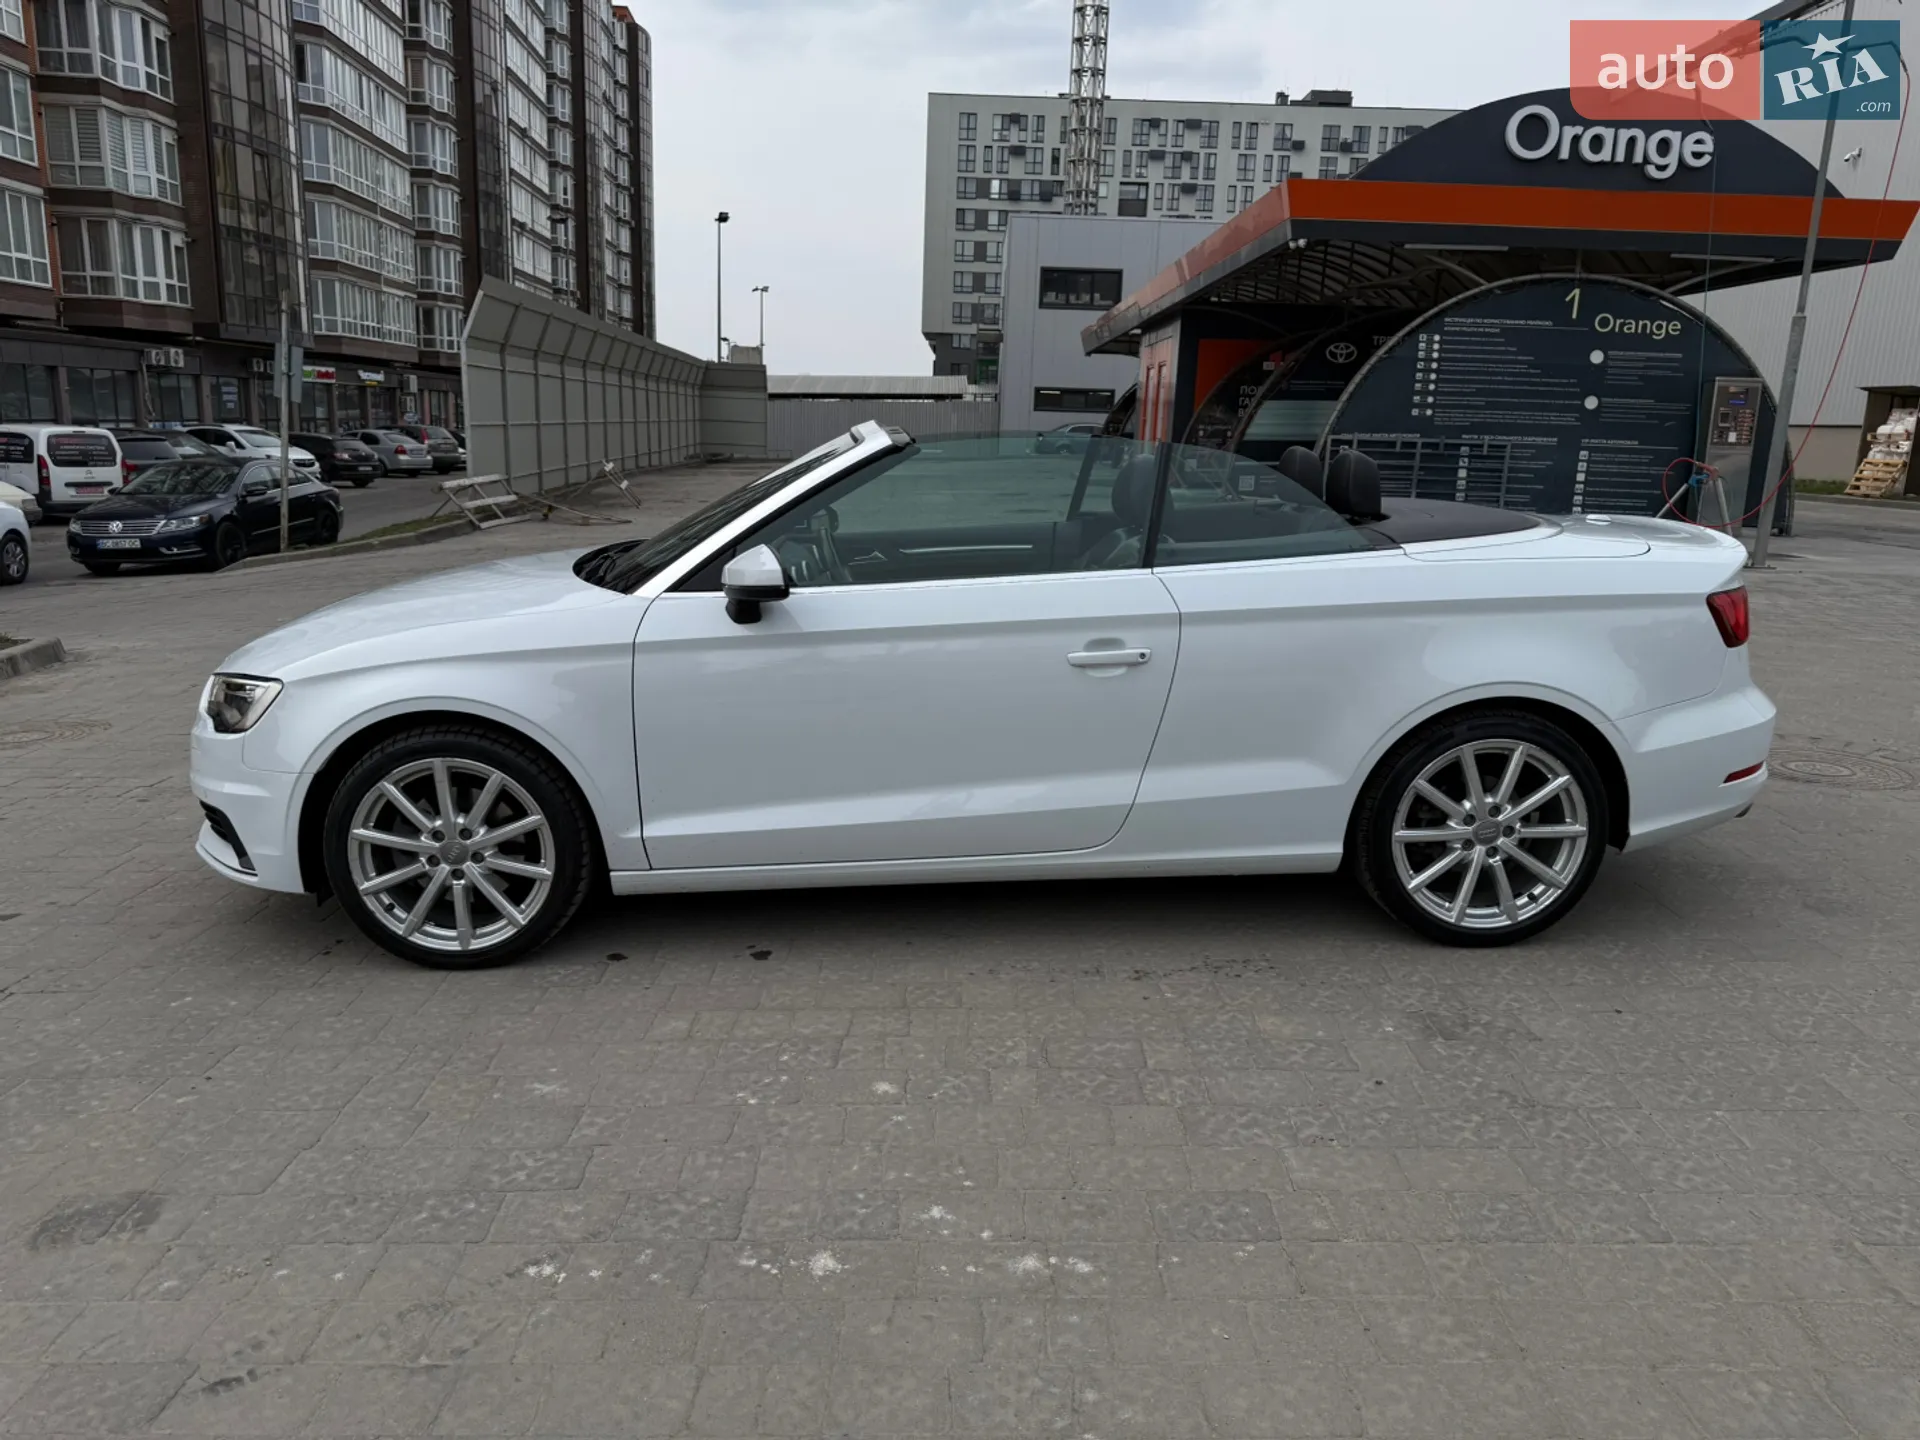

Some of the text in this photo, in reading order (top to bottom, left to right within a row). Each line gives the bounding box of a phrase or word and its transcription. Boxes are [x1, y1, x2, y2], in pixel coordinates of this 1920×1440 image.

[1505, 104, 1715, 179] Orange
[1565, 288, 1581, 319] 1
[1594, 313, 1682, 339] Orange
